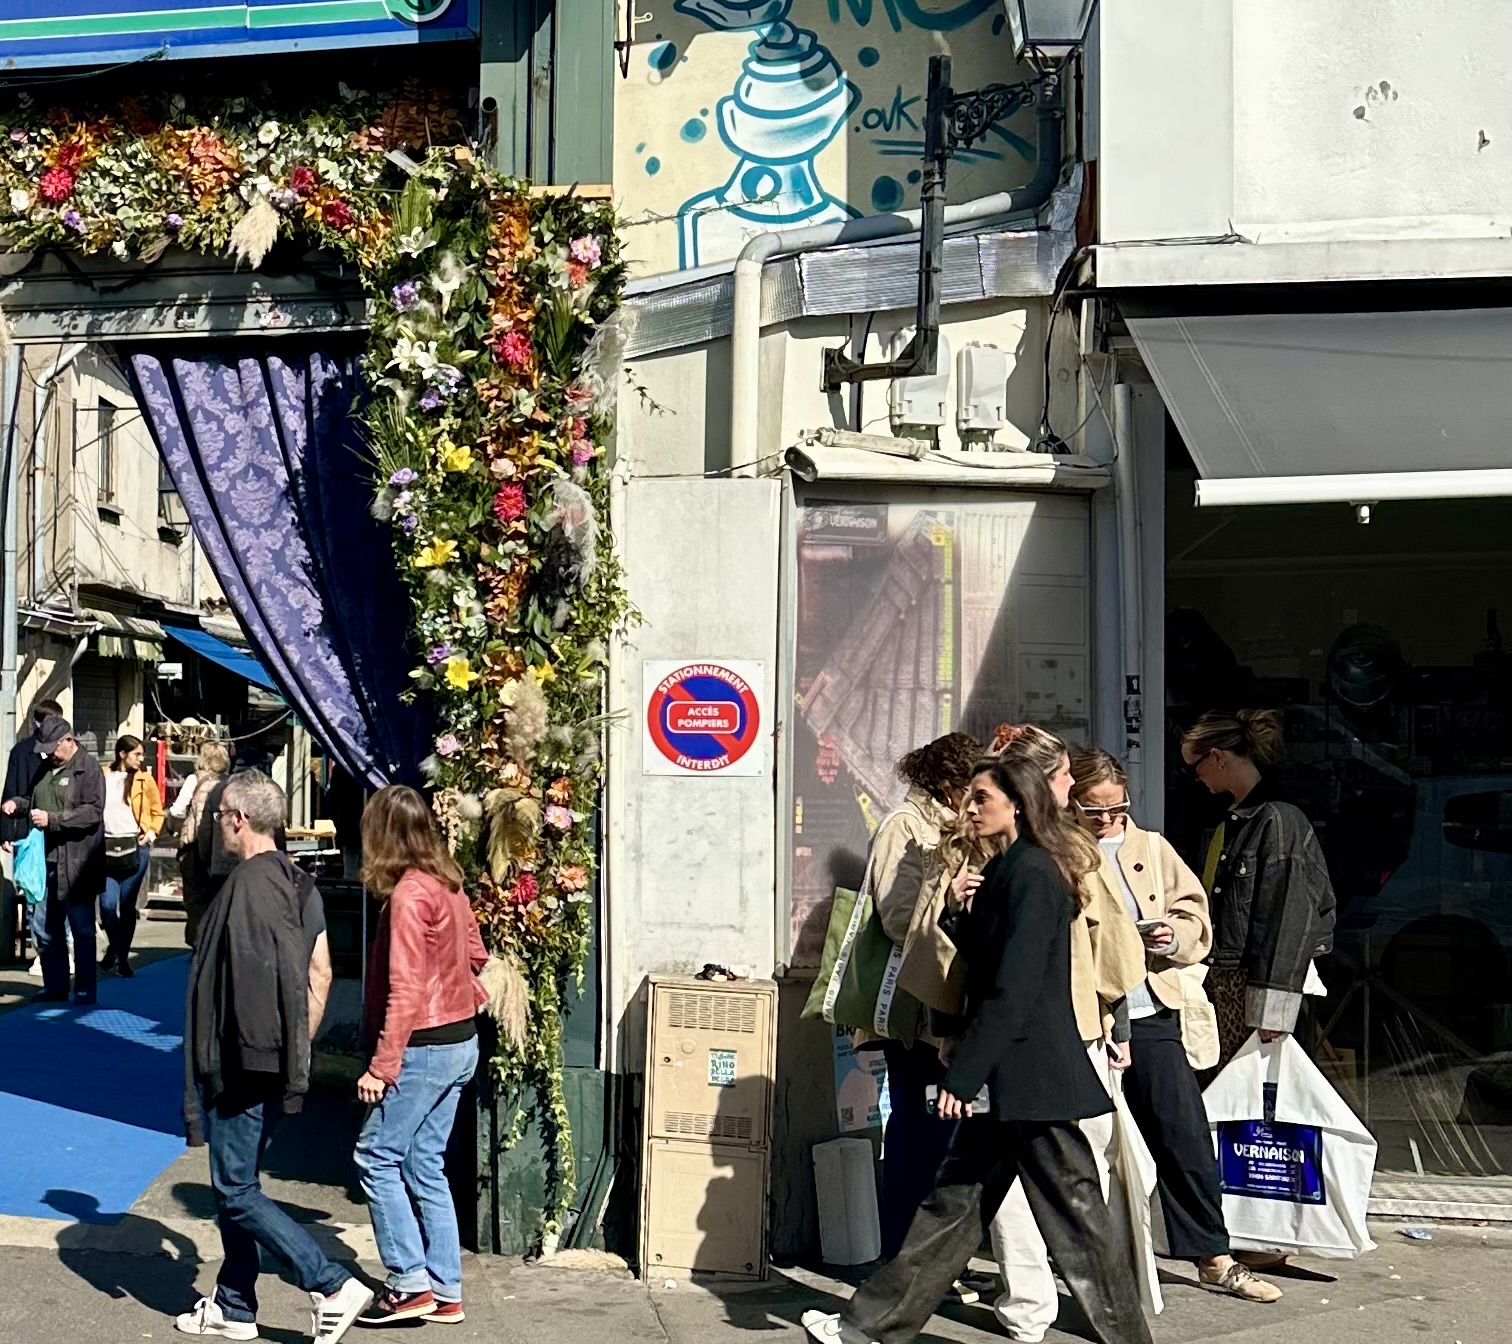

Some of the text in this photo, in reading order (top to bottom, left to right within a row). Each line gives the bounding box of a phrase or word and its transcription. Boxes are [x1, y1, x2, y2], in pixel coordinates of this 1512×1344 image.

[657, 665, 750, 695] STATIONNEMENT
[677, 719, 729, 728] POMPIERS
[676, 753, 730, 770] INTERDIT
[876, 965, 897, 1033] PARIS PARIS
[1233, 1142, 1305, 1163] VERNAISON
